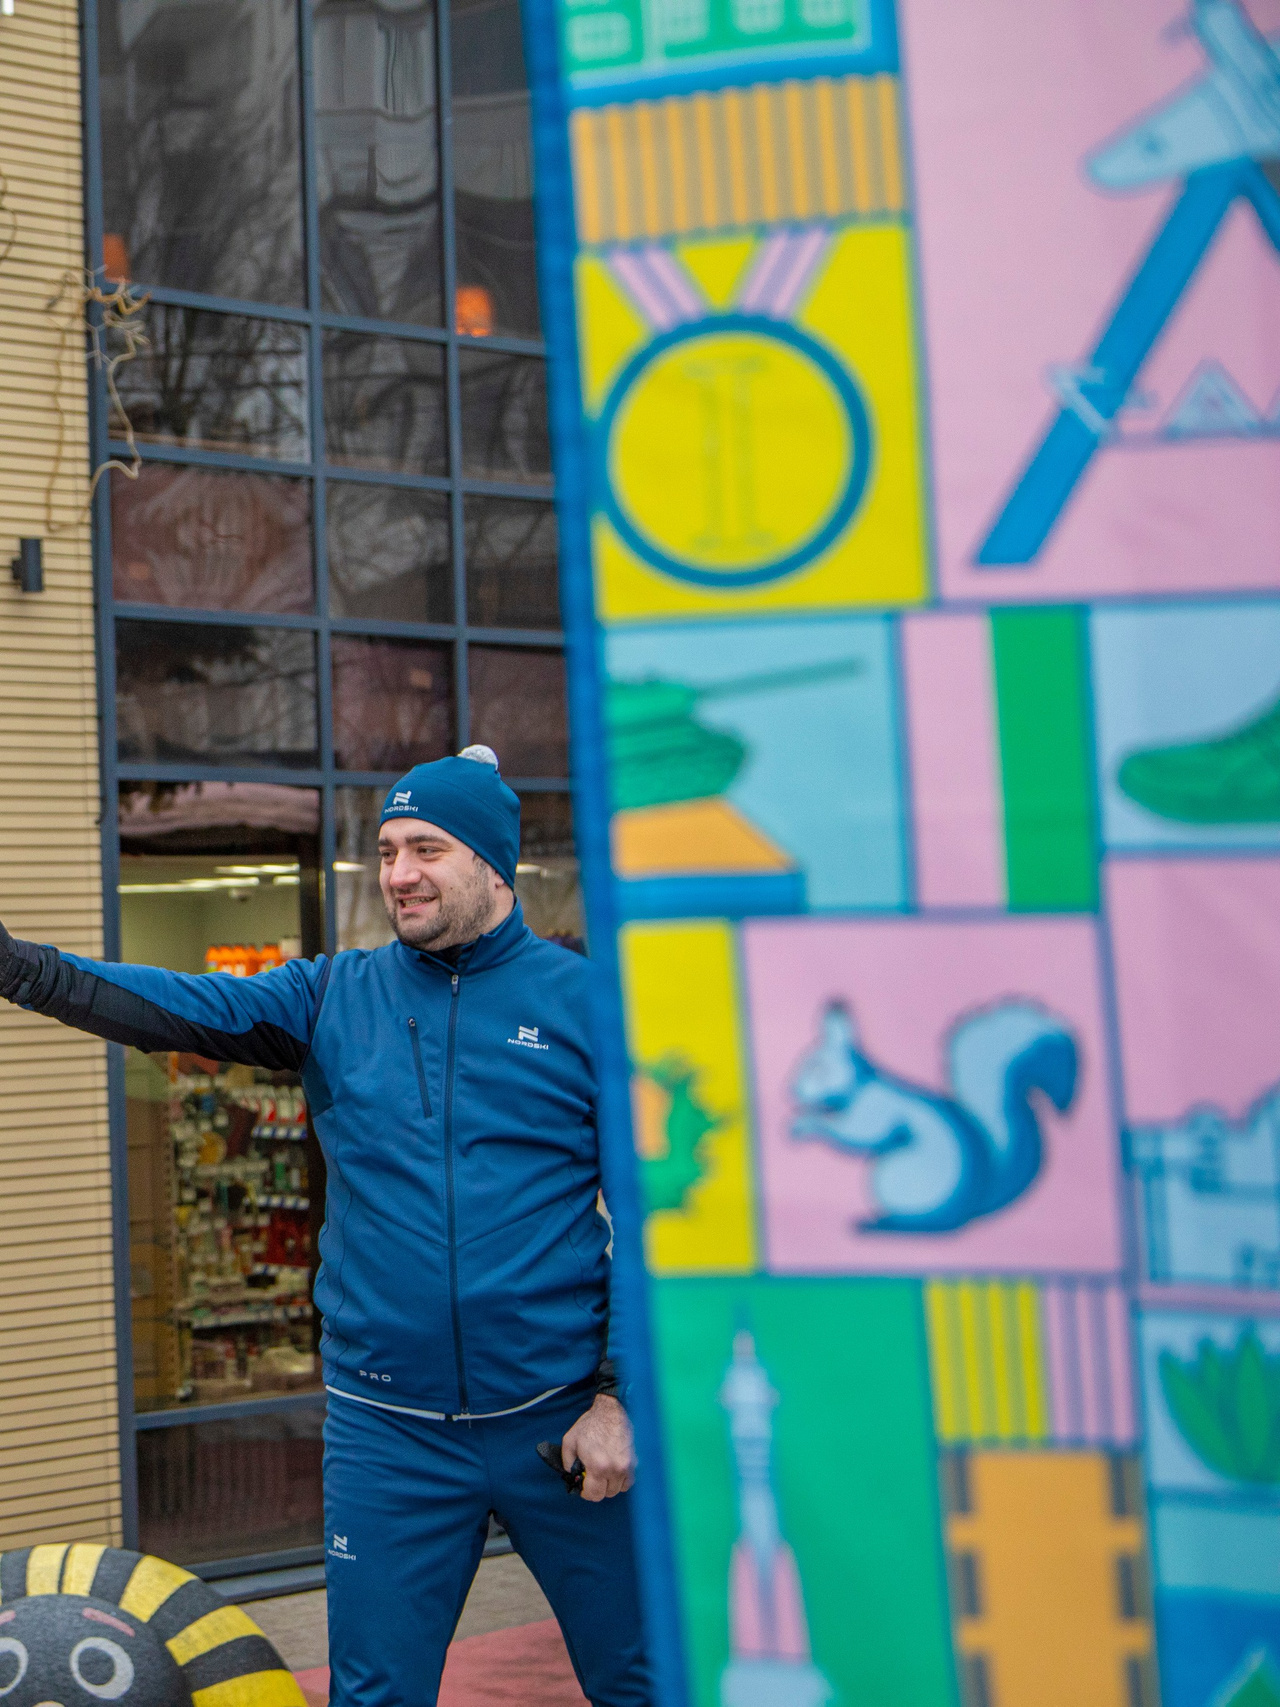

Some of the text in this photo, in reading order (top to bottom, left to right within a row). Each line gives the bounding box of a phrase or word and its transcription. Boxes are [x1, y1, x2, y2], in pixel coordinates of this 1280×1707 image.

[384, 805, 419, 814] NORDSKI
[507, 1038, 549, 1050] NORDSKI
[359, 1369, 392, 1382] PRO
